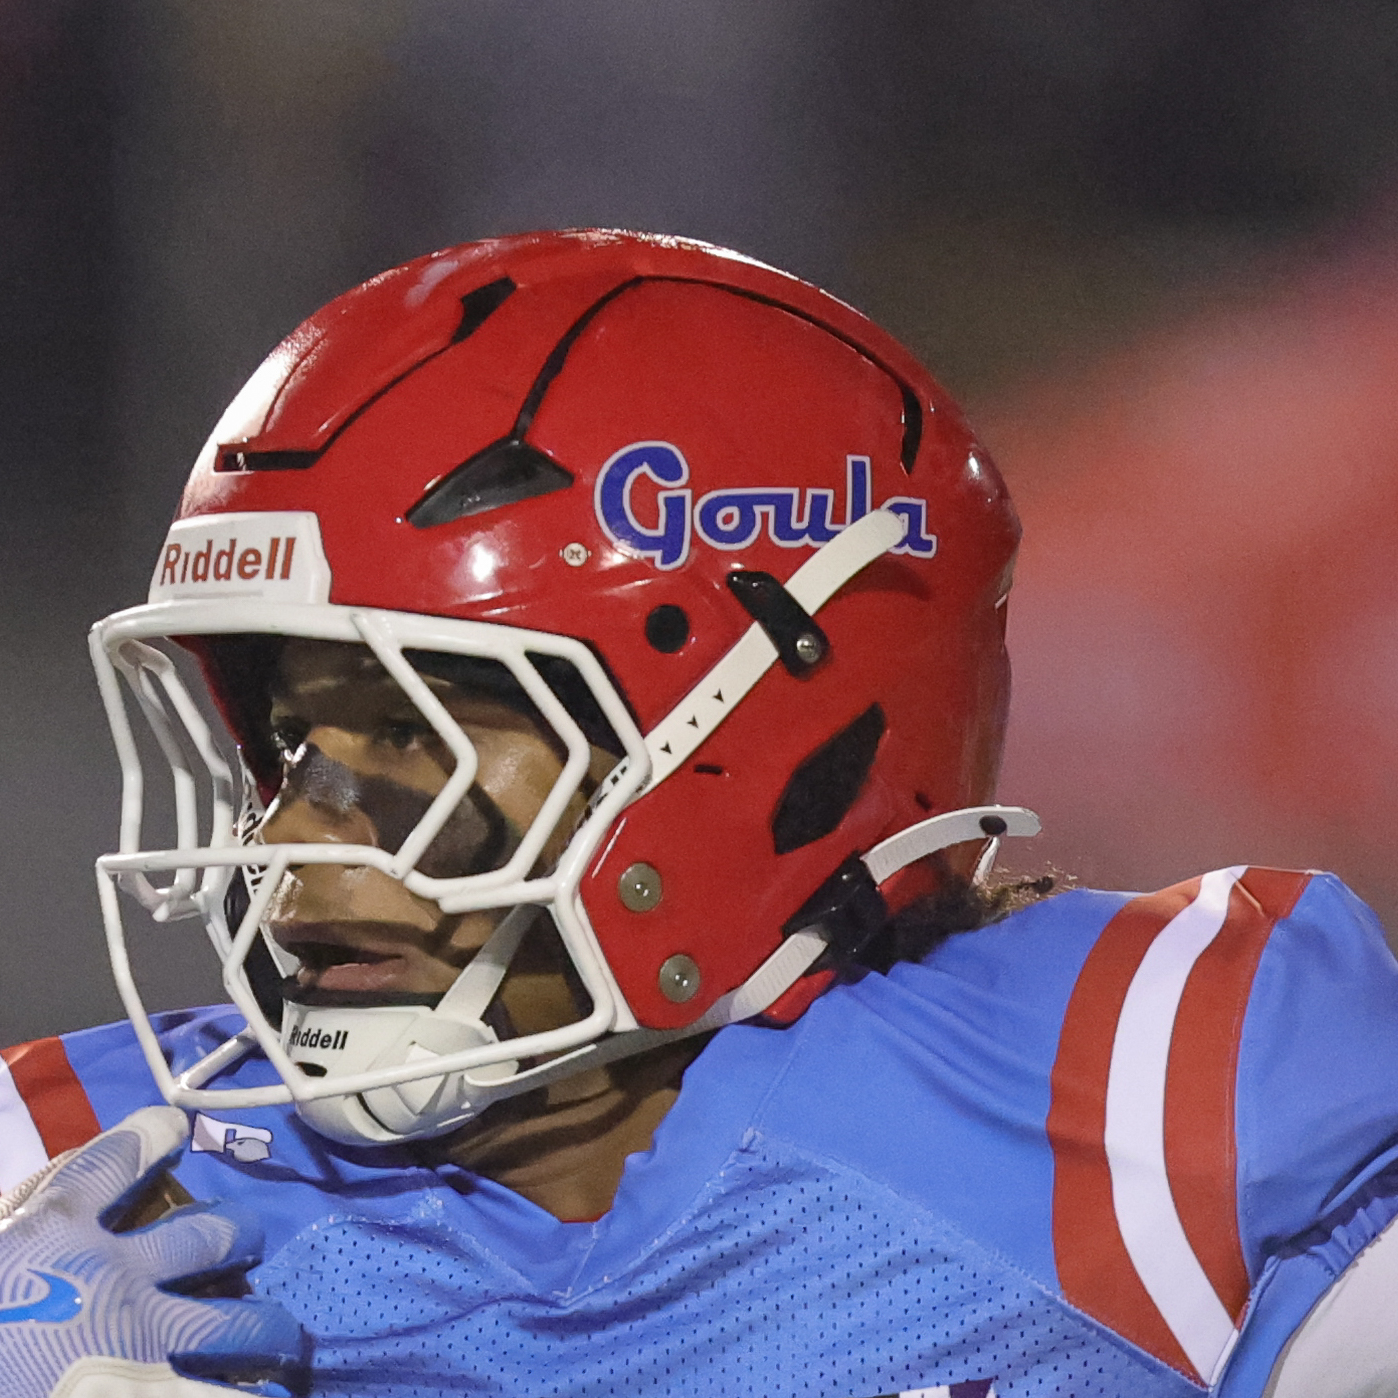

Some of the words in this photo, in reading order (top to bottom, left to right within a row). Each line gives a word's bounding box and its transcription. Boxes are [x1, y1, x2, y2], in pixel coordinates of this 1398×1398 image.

[594, 440, 937, 571] Goula
[159, 536, 297, 586] Riddell
[289, 1024, 349, 1051] Riddell
